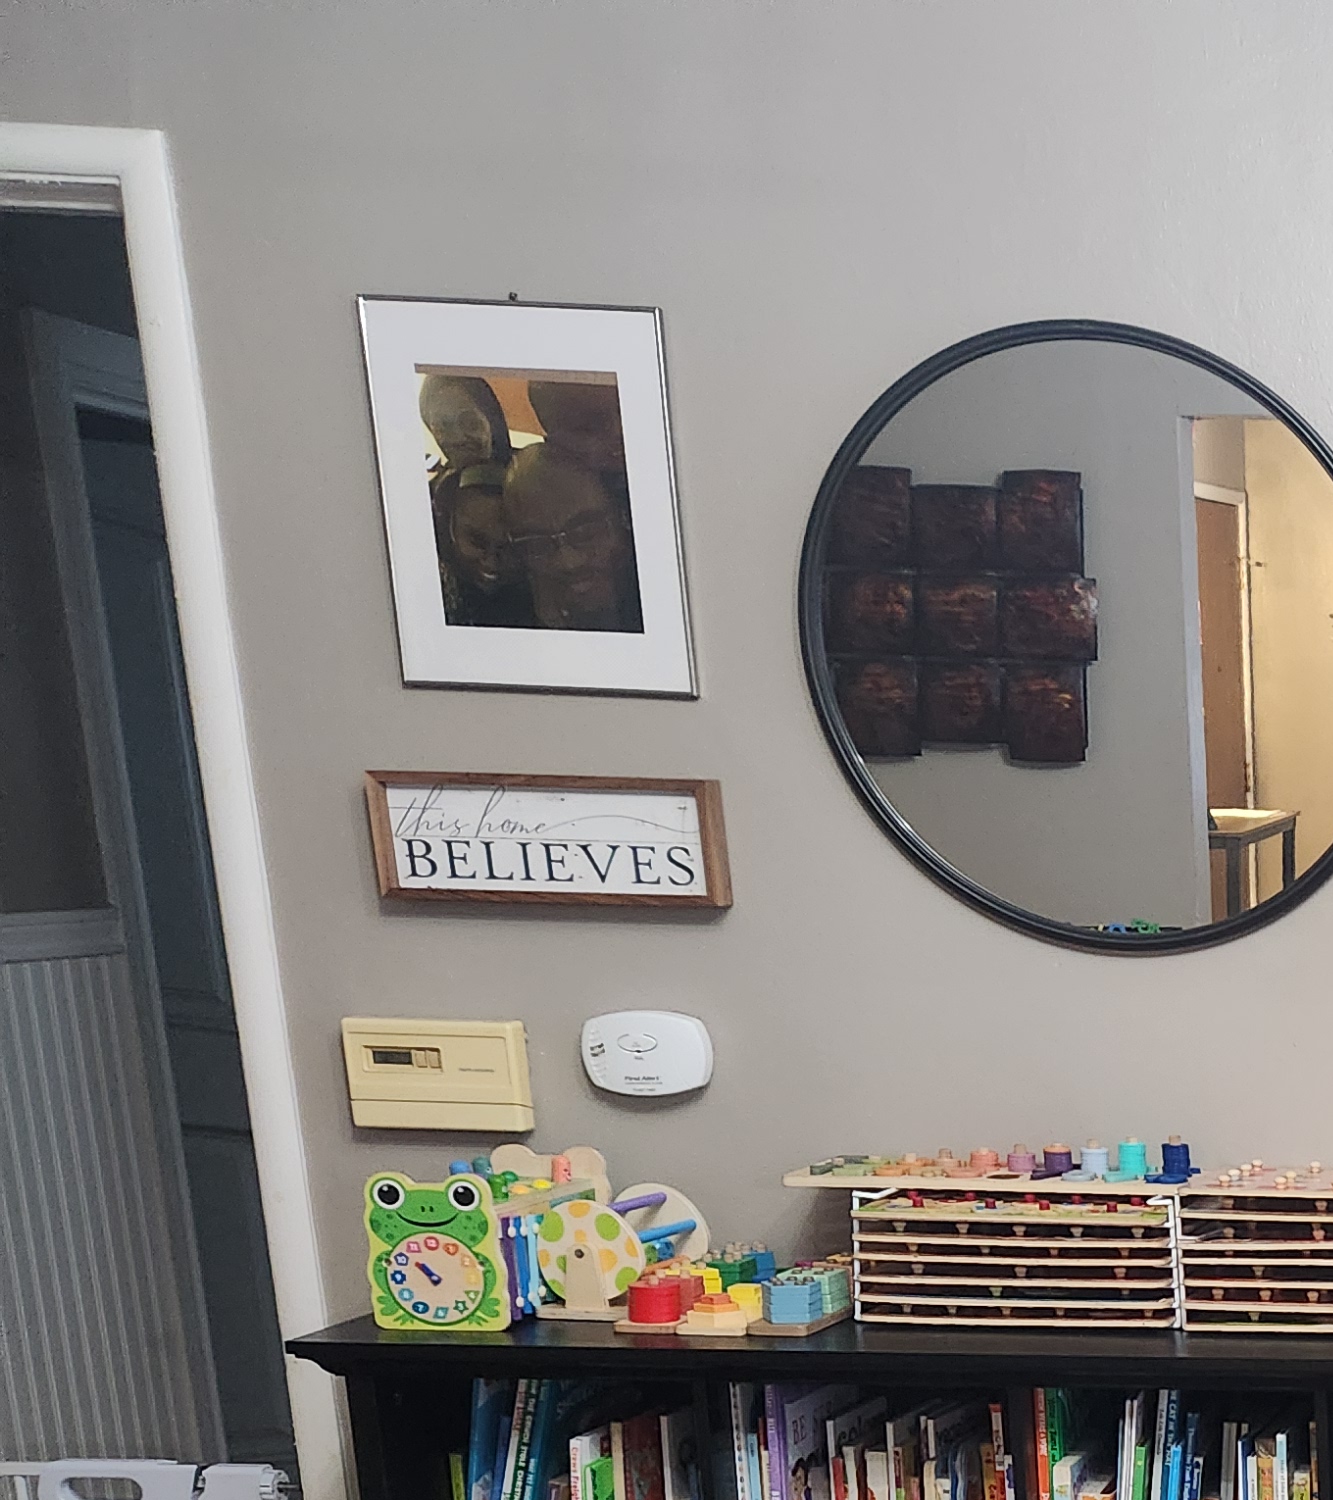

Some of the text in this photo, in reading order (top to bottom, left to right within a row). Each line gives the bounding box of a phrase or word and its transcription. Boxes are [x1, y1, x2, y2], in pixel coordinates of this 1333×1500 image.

[389, 783, 470, 837] this
[405, 838, 696, 886] BELIEVES
[1167, 1403, 1178, 1420] CAT
